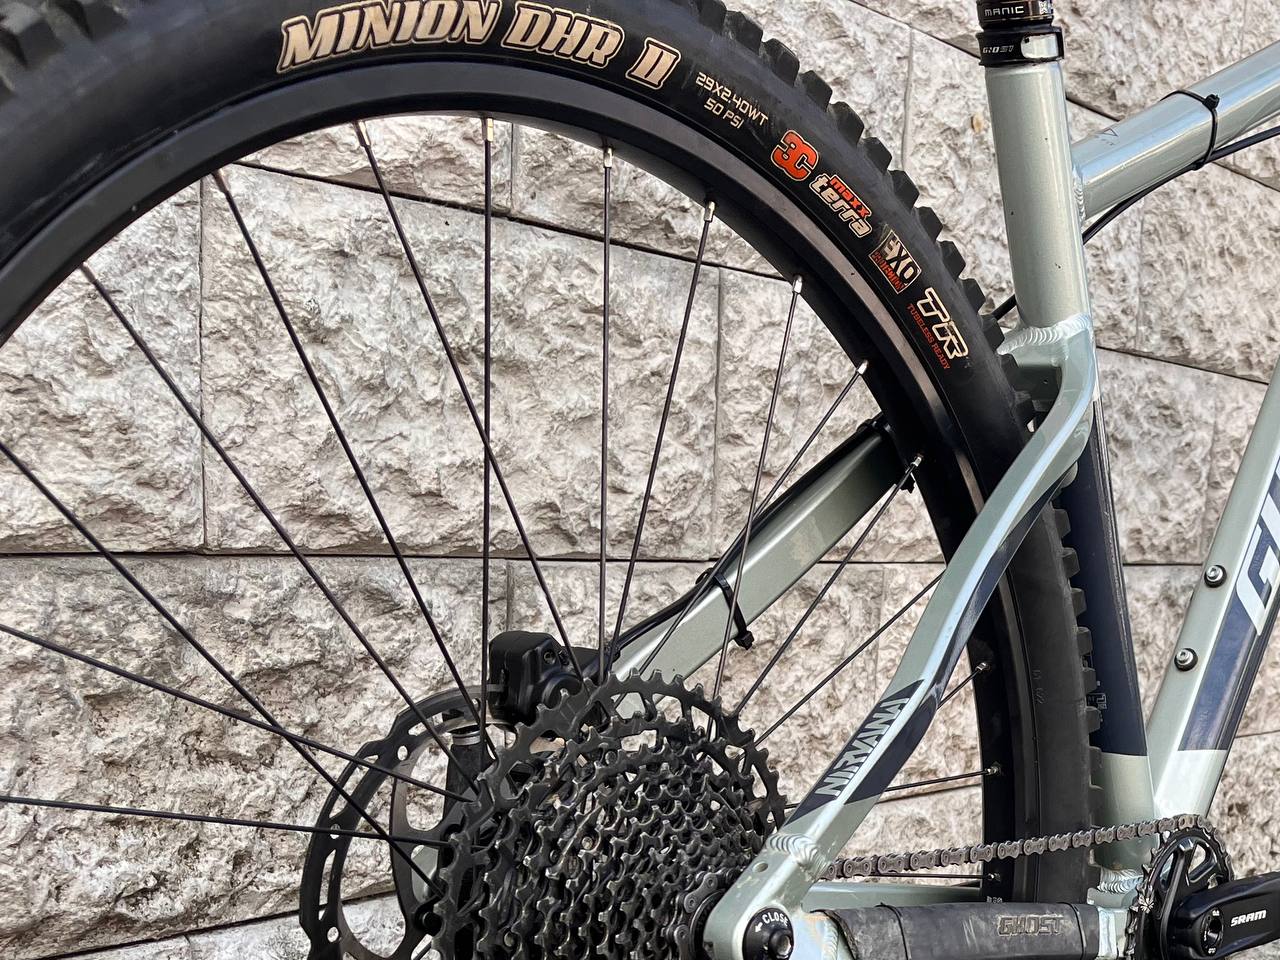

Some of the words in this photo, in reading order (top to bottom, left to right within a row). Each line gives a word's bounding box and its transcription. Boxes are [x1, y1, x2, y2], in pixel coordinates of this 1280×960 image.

[984, 6, 1025, 16] MANIC
[277, 0, 500, 73] MINION
[501, 1, 625, 69] DHR
[695, 72, 769, 126] 29X2.40WT
[704, 98, 723, 115] 50
[723, 109, 745, 129] PSI
[771, 130, 819, 181] 3C
[880, 234, 920, 286] EXO
[917, 287, 969, 359] TR
[930, 341, 950, 369] READY
[815, 698, 910, 797] NIRVANA
[762, 912, 789, 927] CLOSE
[997, 914, 1065, 937] GHOST
[1231, 910, 1267, 927] SRAM
